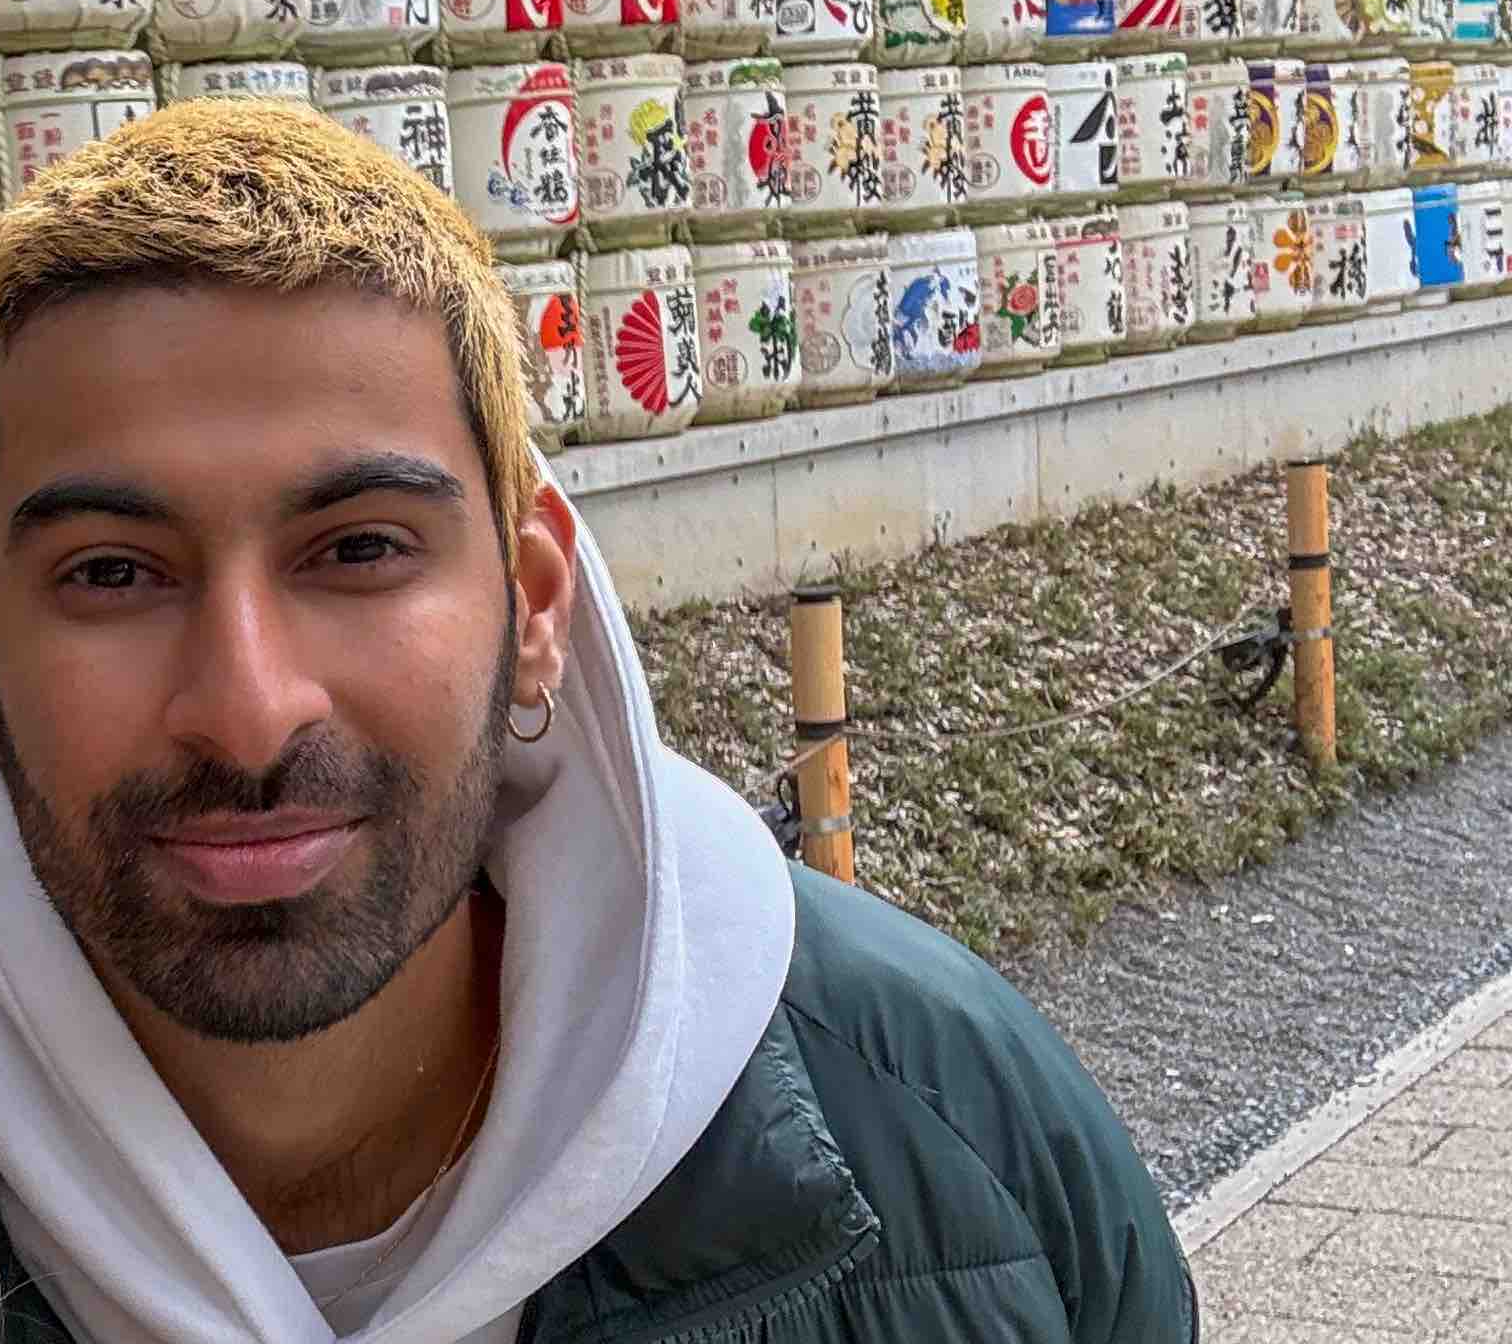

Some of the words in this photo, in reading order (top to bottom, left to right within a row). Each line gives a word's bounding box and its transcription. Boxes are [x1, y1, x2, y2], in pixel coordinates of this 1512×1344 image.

[530, 105, 570, 204] 香住鶴
[665, 287, 704, 409] 菊美人
